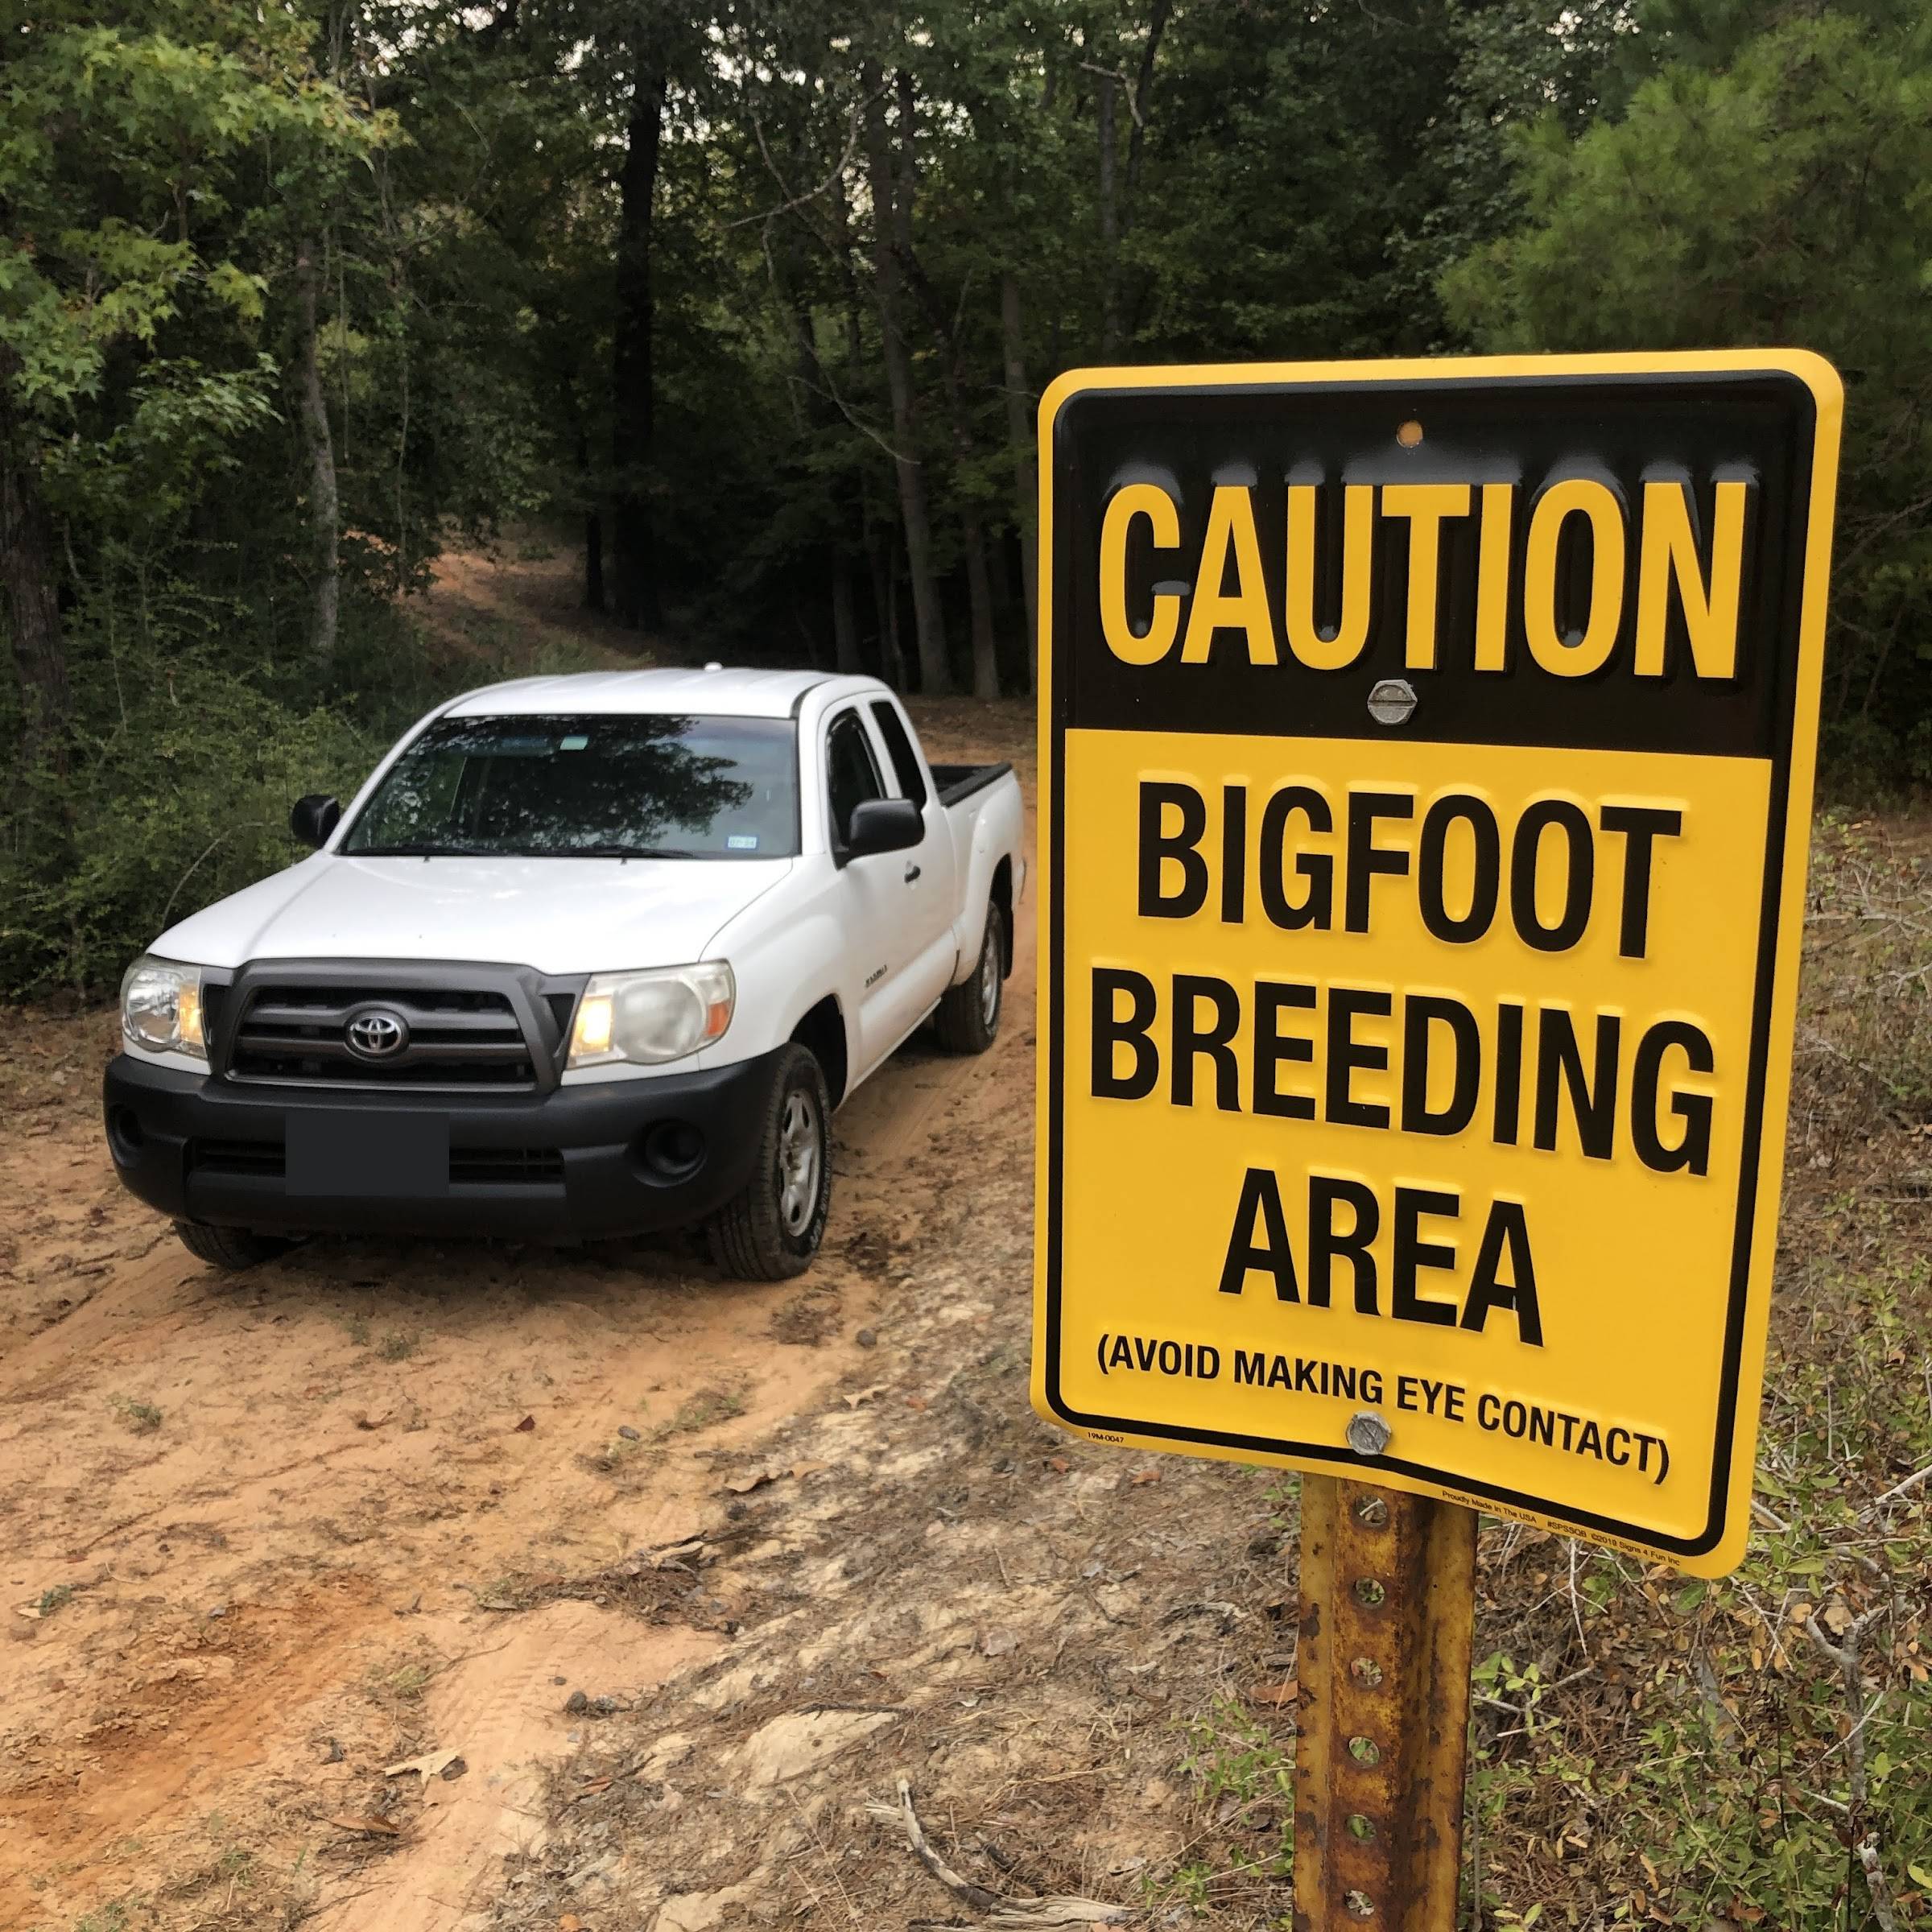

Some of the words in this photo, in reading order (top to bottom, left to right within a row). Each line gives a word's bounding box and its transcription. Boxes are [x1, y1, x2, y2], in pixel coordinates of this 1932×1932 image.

[1100, 479, 1747, 679] CAUTION
[1138, 782, 1682, 959] BIGFOOT
[1091, 967, 1714, 1177] BREEDING
[1218, 1167, 1544, 1348] AREA
[1088, 1431, 1125, 1443] 19M-0047
[1098, 1334, 1220, 1379] (AVOID
[1234, 1350, 1383, 1405] MAKING
[1397, 1376, 1465, 1422] EYE
[1478, 1393, 1670, 1485] CONTACT)
[1442, 1490, 1470, 1505] Proudly
[1472, 1498, 1492, 1511] Made
[1503, 1507, 1517, 1518] The
[1519, 1512, 1538, 1524] USA
[1619, 1541, 1641, 1554] Signs
[1650, 1550, 1666, 1562] Fun
[1668, 1555, 1681, 1567] Inc
